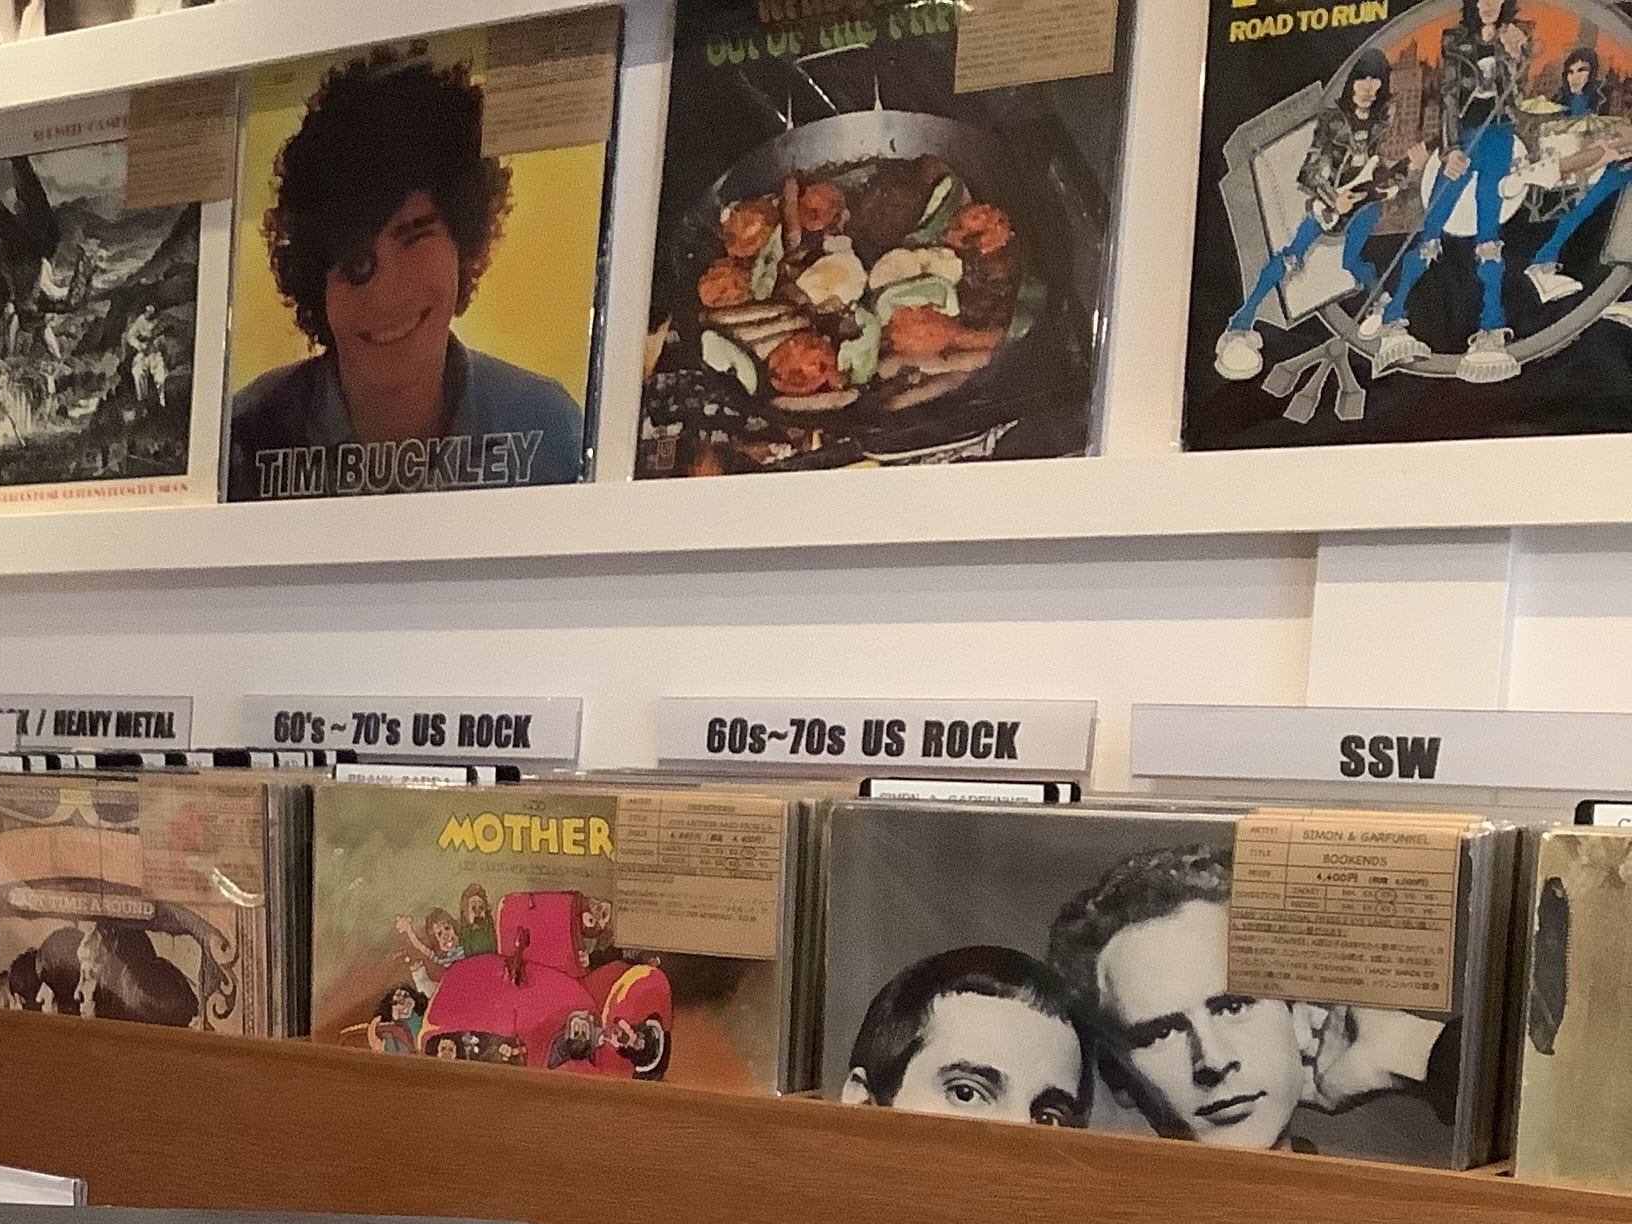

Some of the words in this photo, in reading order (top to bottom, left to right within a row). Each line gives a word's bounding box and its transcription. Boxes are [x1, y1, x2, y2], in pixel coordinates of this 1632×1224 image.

[1229, 14, 1294, 42] ROAD
[1297, 8, 1329, 32] TO
[1331, 0, 1389, 27] RUIN
[256, 446, 326, 498] TIM
[337, 430, 544, 493] BUCKLEY
[53, 709, 113, 737] HEAVY
[115, 711, 177, 739] METAL
[412, 713, 447, 747] US
[458, 714, 533, 749] ROCK
[861, 719, 906, 757] US
[921, 720, 1021, 760] ROCK
[1339, 734, 1442, 779] SSW
[1302, 829, 1343, 842] SIMON
[1360, 831, 1430, 846] GARFUNKEL
[1322, 853, 1389, 867] BOOKENDS
